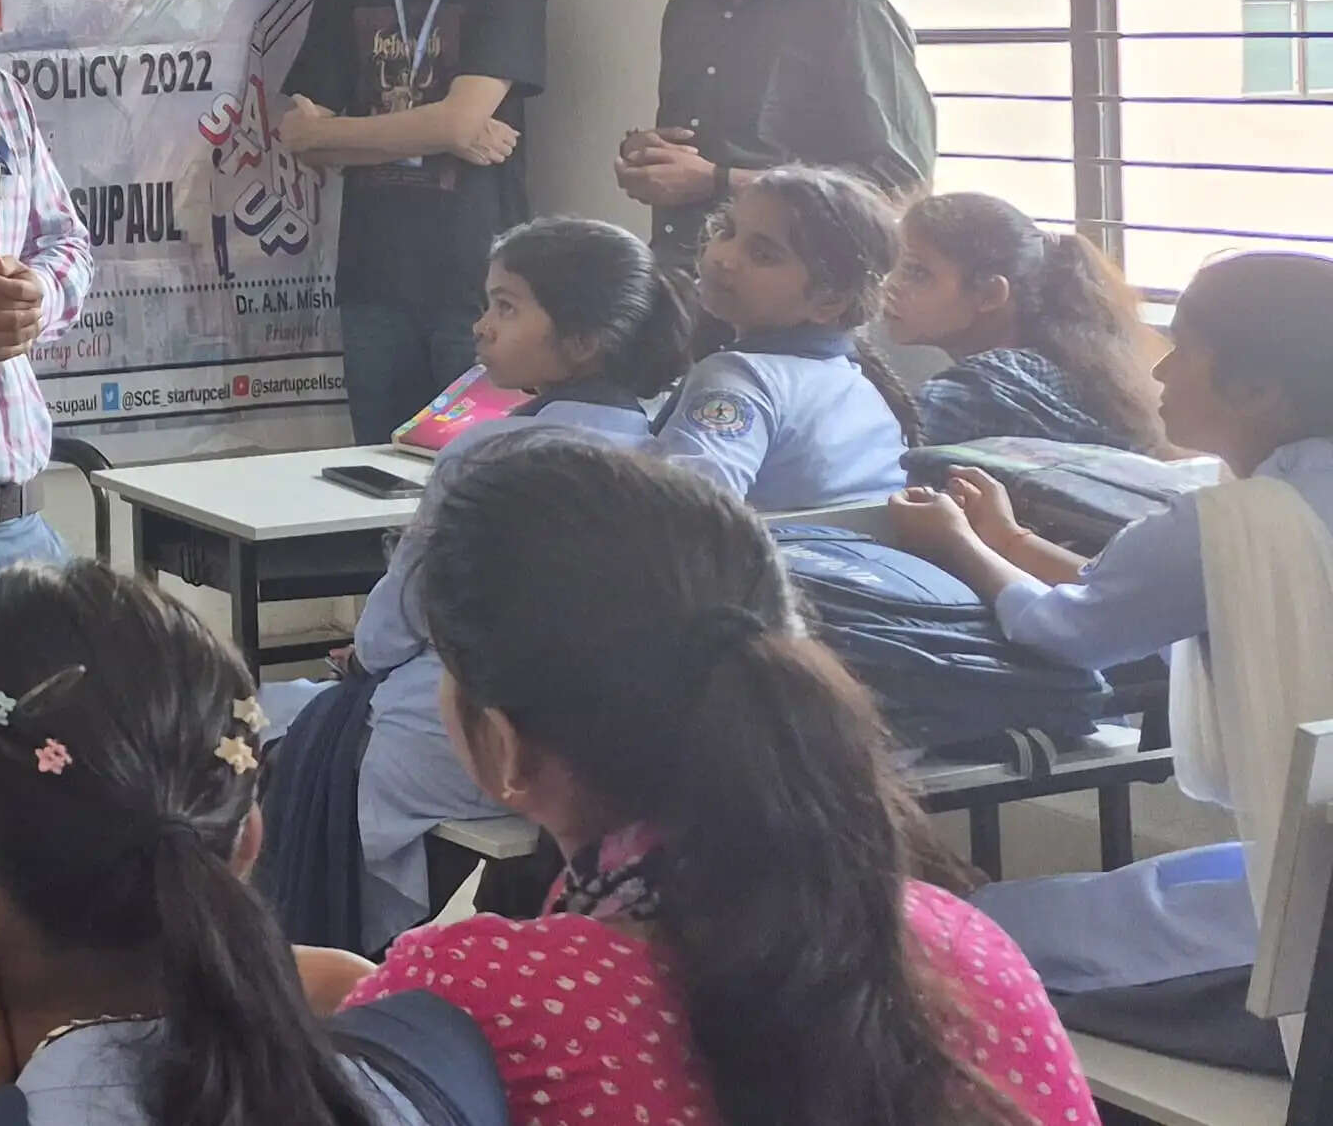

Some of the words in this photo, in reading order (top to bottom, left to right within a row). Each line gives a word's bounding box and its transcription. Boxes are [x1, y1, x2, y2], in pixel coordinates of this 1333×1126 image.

[12, 54, 128, 100] POLICY
[139, 49, 213, 95] 2022
[70, 181, 182, 247] SUPAUL
[236, 292, 259, 315] Dr.
[262, 290, 293, 313] A.N.
[121, 382, 231, 411] @SCE_startupcell
[250, 373, 346, 398] @startupcellsc
